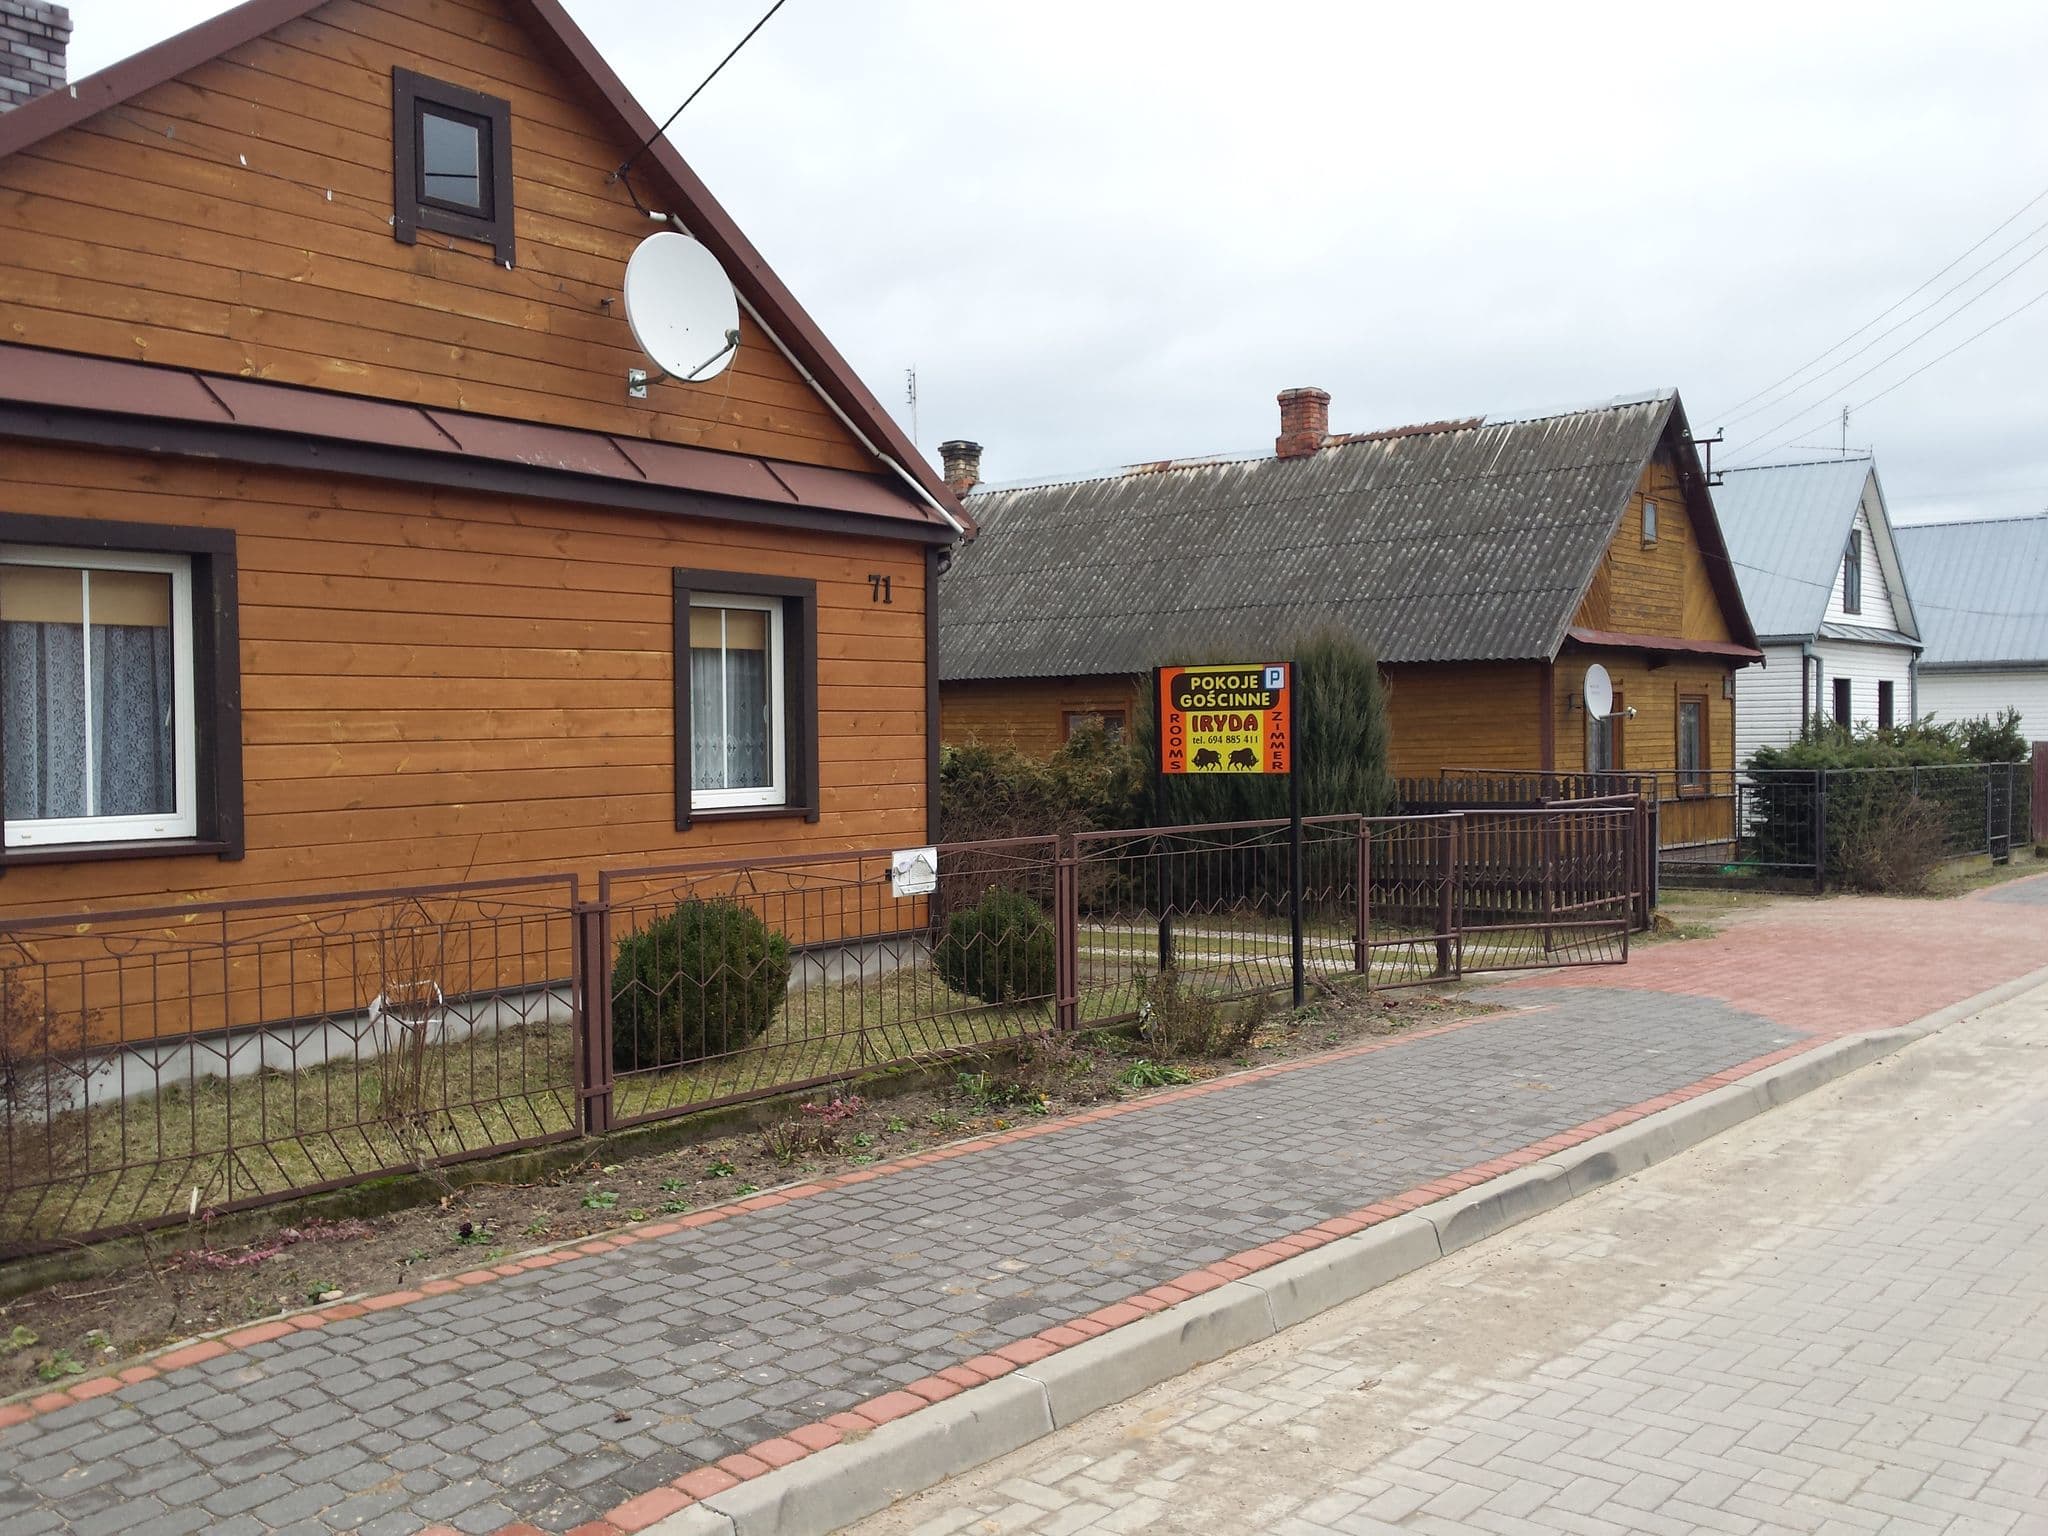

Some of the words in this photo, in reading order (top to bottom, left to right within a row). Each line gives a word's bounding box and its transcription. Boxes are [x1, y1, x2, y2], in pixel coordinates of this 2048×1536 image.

[867, 574, 893, 605] 71
[1190, 675, 1259, 691] POKOJE
[1270, 670, 1280, 686] P
[1180, 690, 1271, 708] GOŚCINNE
[1191, 713, 1259, 733] IRYDA
[1169, 713, 1184, 770] ROOMS
[1192, 735, 1206, 745] tel.
[1208, 735, 1223, 744] 694
[1225, 735, 1241, 744] 885
[1243, 735, 1259, 744] 411
[1270, 711, 1285, 770] ZIMMER
